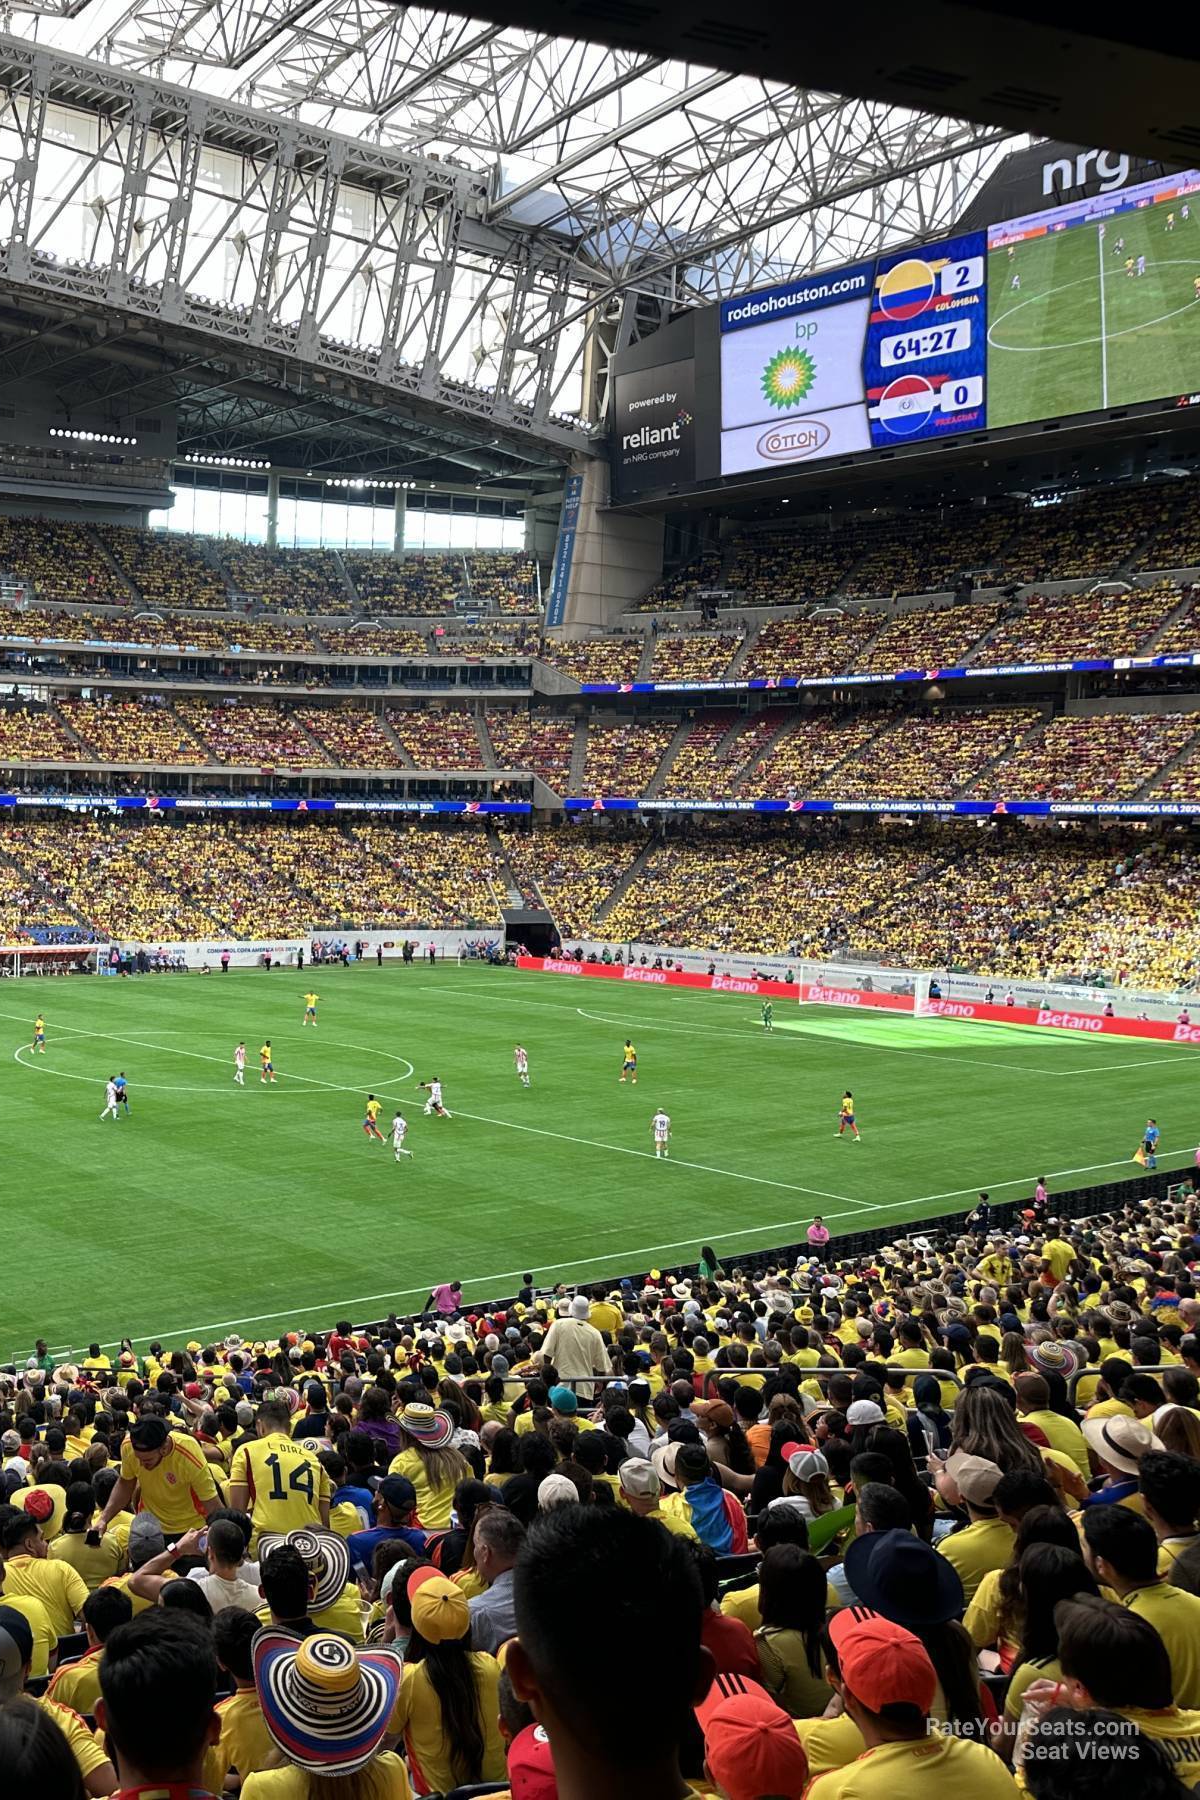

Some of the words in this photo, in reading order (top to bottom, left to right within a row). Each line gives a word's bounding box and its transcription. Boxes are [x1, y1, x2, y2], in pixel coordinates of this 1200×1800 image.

[1043, 149, 1129, 195] nrg
[955, 266, 970, 287] 2
[727, 274, 866, 322] rodeohouston.com
[935, 295, 979, 313] COLOMBIA
[795, 321, 818, 340] bp
[893, 327, 957, 361] 64:27
[628, 394, 665, 412] powered
[666, 392, 677, 403] by
[954, 386, 968, 404] 0
[622, 421, 681, 450] reliant
[766, 430, 818, 453] COTTON
[623, 457, 632, 465] an
[632, 452, 648, 462] NRG
[648, 447, 680, 461] company
[833, 802, 871, 810] CONMEBOL
[1050, 803, 1096, 812] CONMEBOL
[1097, 804, 1121, 813] COPA
[1120, 804, 1160, 813] AMERICA
[1161, 804, 1179, 813] USA
[543, 958, 582, 975] Betano
[623, 968, 667, 984] Betano
[712, 976, 759, 994] Betano
[808, 987, 860, 1004] Betano
[1036, 1010, 1103, 1032] Betano
[264, 1453, 314, 1505] 14
